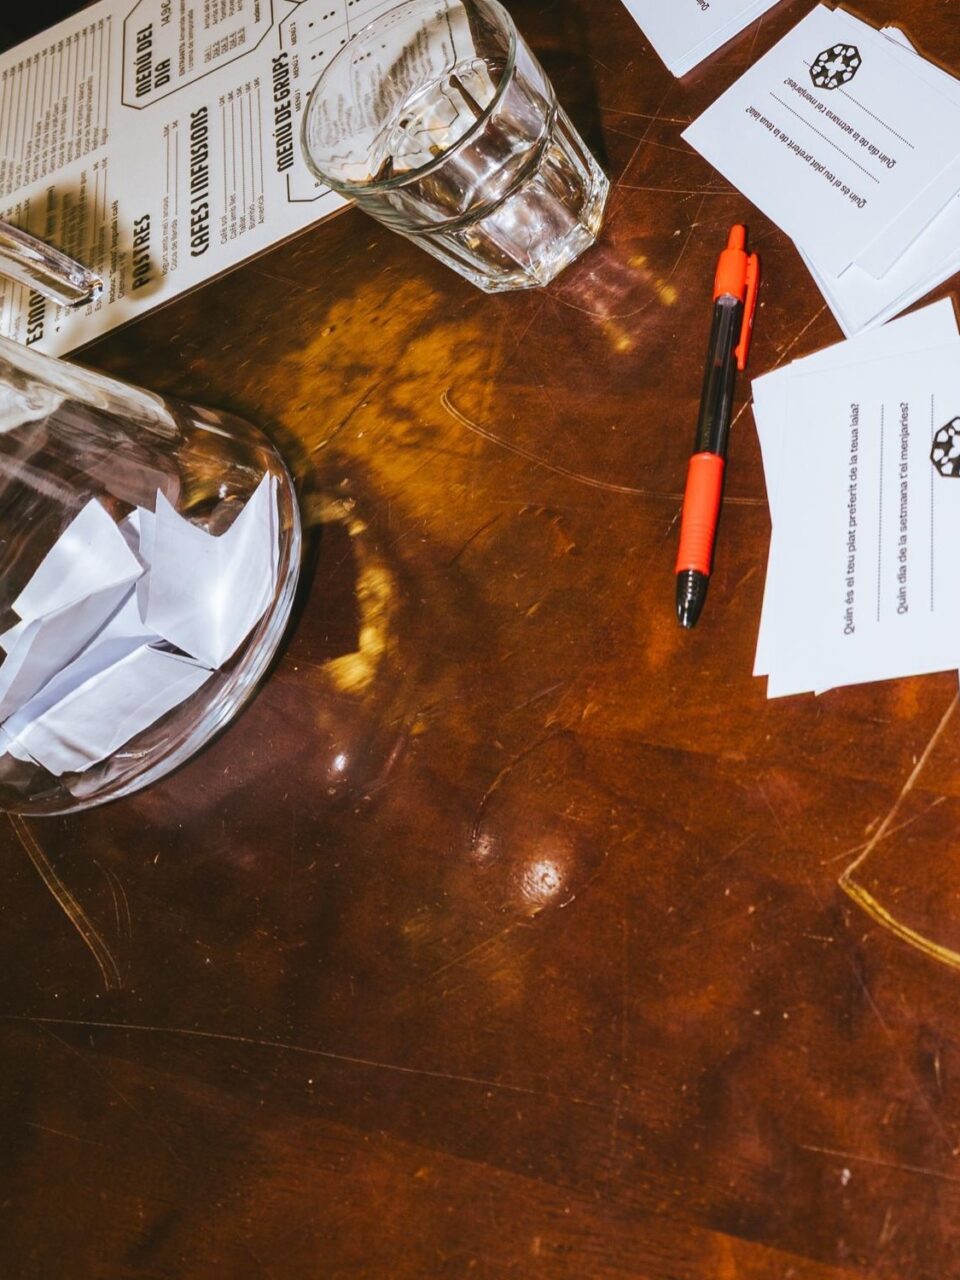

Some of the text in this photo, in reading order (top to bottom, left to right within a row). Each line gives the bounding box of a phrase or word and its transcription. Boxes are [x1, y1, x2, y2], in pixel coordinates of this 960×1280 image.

[134, 23, 152, 97] MENÚ DEL
[160, 0, 171, 26] 14,9€
[154, 58, 170, 88] DIA
[272, 52, 293, 171] MENÚ DE GRUPS
[745, 105, 866, 208] Quin és el teu plat preferit de la teua iaia?
[783, 77, 896, 168] Quin dia de la setmana t'el menjaries?
[190, 107, 209, 256] CAFES I INFUSIONS
[131, 215, 150, 290] POSTRES
[843, 403, 859, 635] Quin és el teu plat preferit de la teua iaia?
[896, 402, 909, 614] Quin dia de la setmana t'el menjaries?
